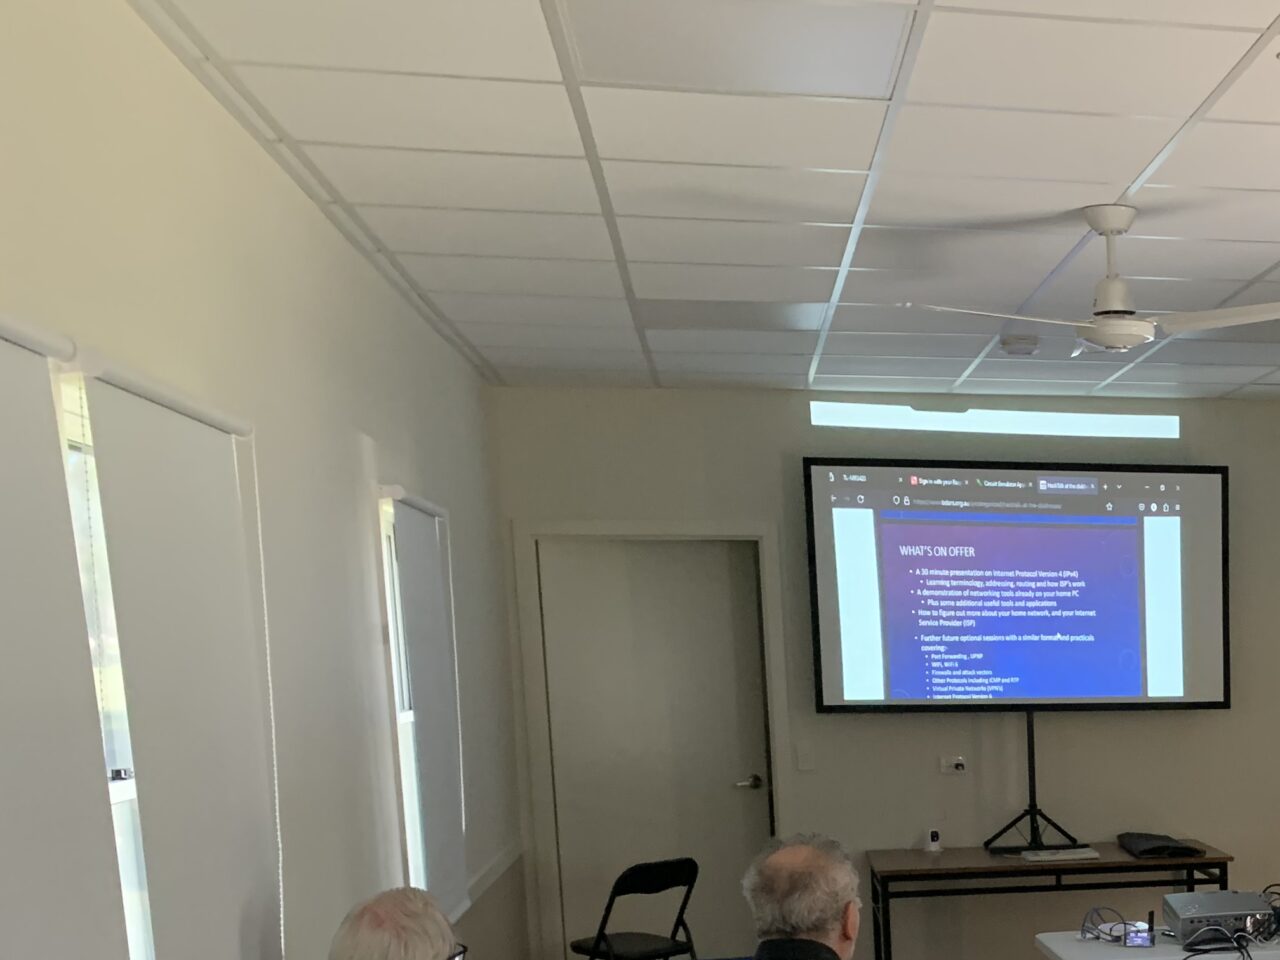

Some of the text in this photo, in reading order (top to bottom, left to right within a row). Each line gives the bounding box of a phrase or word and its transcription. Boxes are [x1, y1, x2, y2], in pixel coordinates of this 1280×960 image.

[899, 545, 976, 557] WHAT'S ON OFFER
[949, 569, 984, 577] presentation
[938, 609, 955, 617] figure
[960, 634, 982, 642] optional
